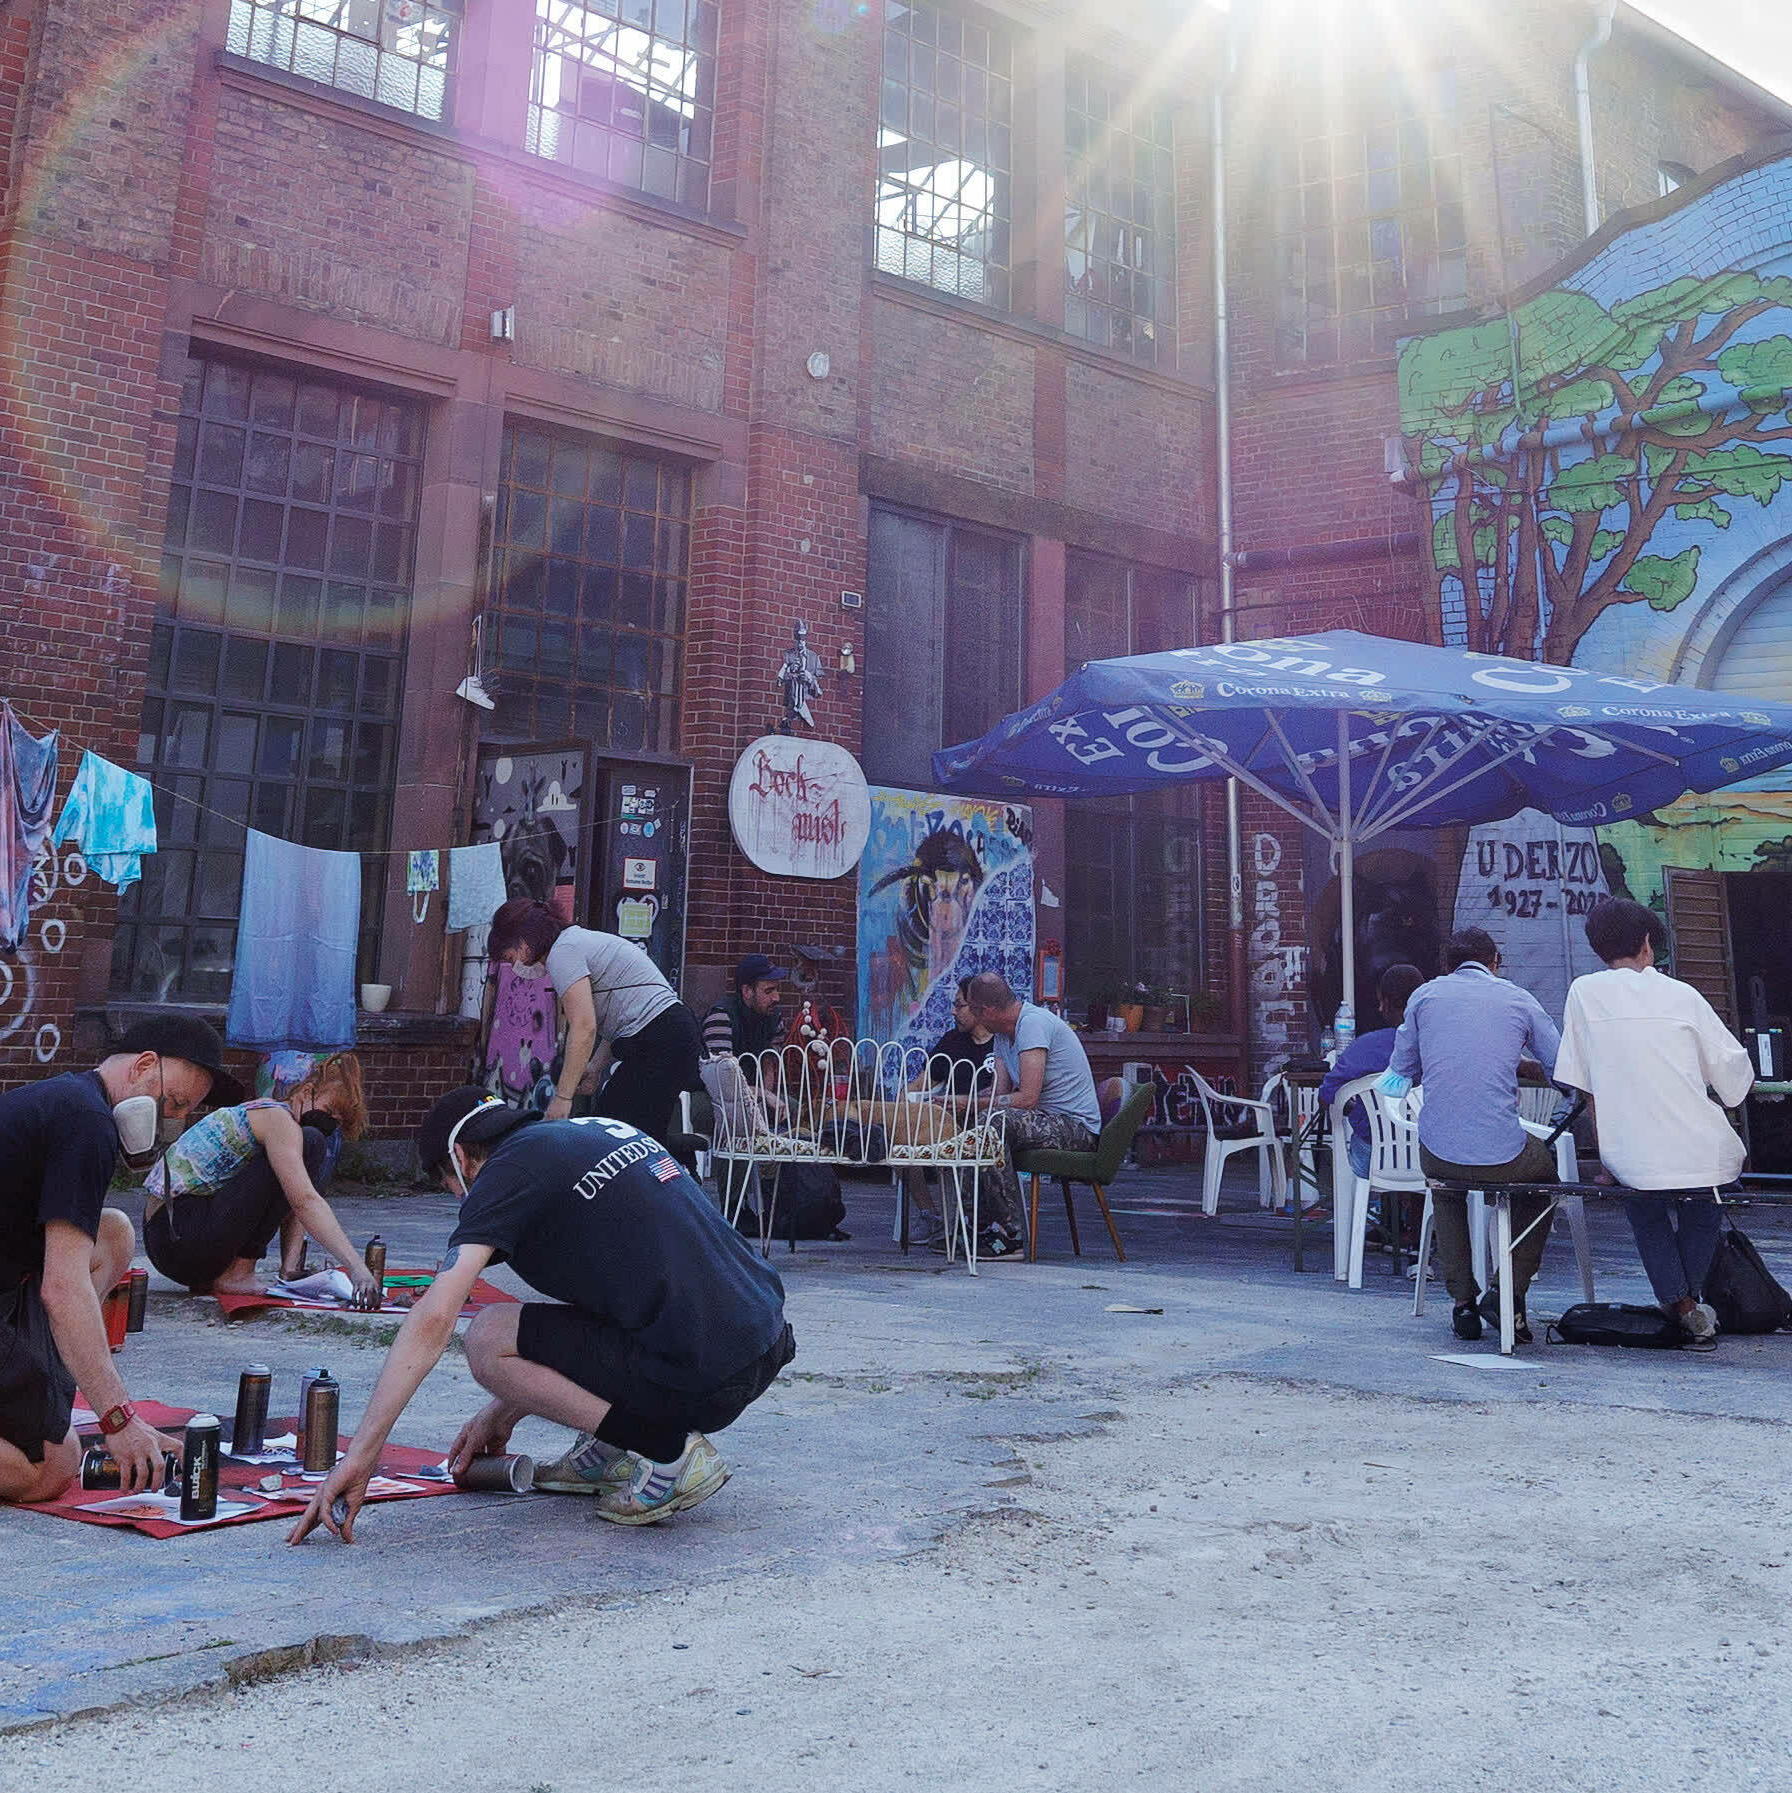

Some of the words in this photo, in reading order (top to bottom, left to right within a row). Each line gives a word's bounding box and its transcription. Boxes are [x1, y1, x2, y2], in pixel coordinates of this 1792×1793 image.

[1217, 682, 1291, 698] Corona
[1601, 706, 1675, 719] Corona
[1476, 840, 1599, 885] UDERZO
[573, 1141, 649, 1200] UNITED
